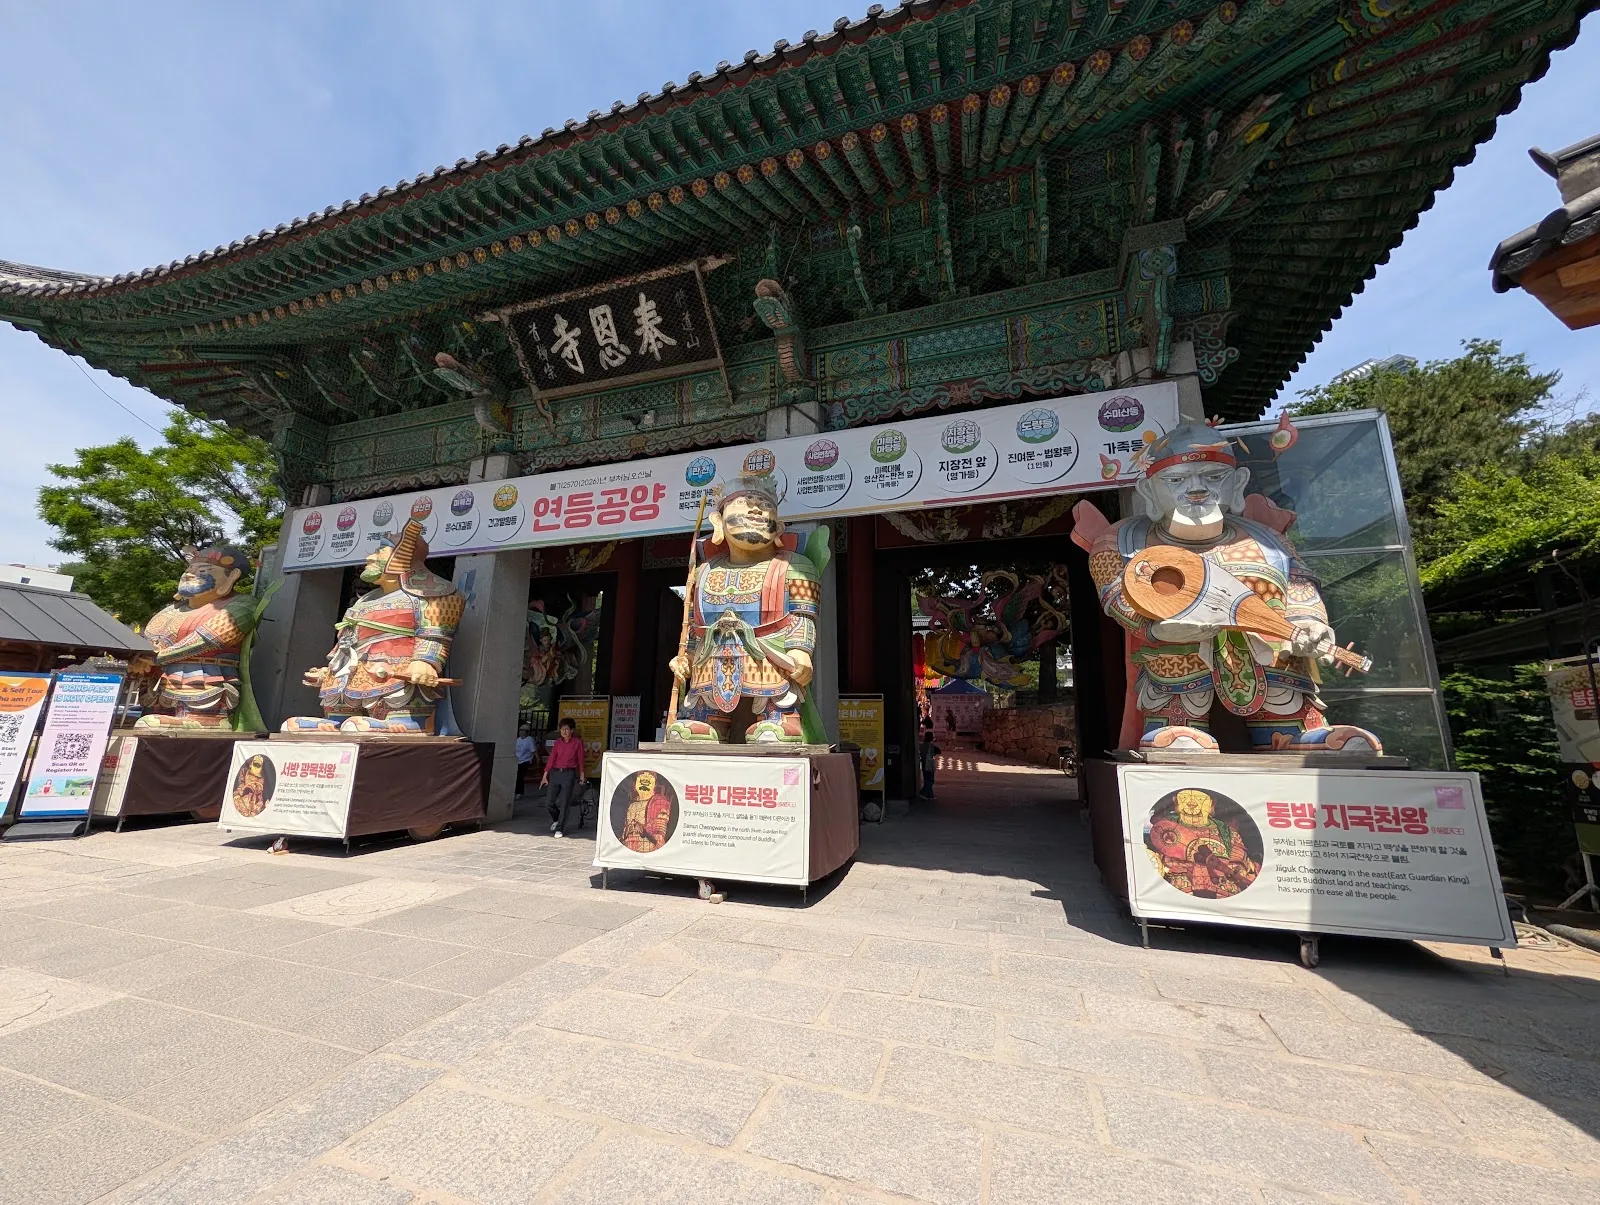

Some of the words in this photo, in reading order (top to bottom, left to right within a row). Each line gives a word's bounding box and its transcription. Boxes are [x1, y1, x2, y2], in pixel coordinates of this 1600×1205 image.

[1103, 406, 1140, 419] 수미산등
[1021, 419, 1054, 431] 도량등
[1103, 439, 1144, 454] 가족등
[938, 457, 972, 472] 지장전
[976, 455, 987, 467] 앞
[532, 482, 667, 532] 연등공양
[54, 694, 63, 703] IS
[63, 694, 85, 703] NOW
[615, 736, 623, 748] P
[280, 761, 300, 777] 서방
[300, 762, 337, 779] 광목천왕
[685, 784, 715, 805] 북방
[717, 786, 779, 808] 다문천왕
[1266, 802, 1317, 829] 동방
[1321, 804, 1429, 835] 지국천왕
[1273, 838, 1296, 847] 부처님
[1357, 842, 1382, 850] 지키고
[1449, 846, 1467, 855] 것을
[1323, 851, 1339, 859] 하여
[1340, 852, 1390, 863] 지국천왕으로
[1298, 865, 1346, 877] Cheonwang
[1356, 869, 1370, 878] the
[1408, 873, 1446, 882] Guardian
[1447, 875, 1470, 885] King)
[1277, 884, 1291, 893] has
[1326, 889, 1344, 897] ease
[1345, 889, 1354, 897] all
[1355, 890, 1368, 898] the
[1370, 892, 1399, 901] people.
[1303, 876, 1336, 886] Buddhist
[1337, 878, 1353, 887] land
[1355, 879, 1370, 888] and
[1371, 881, 1412, 892] teachings,
